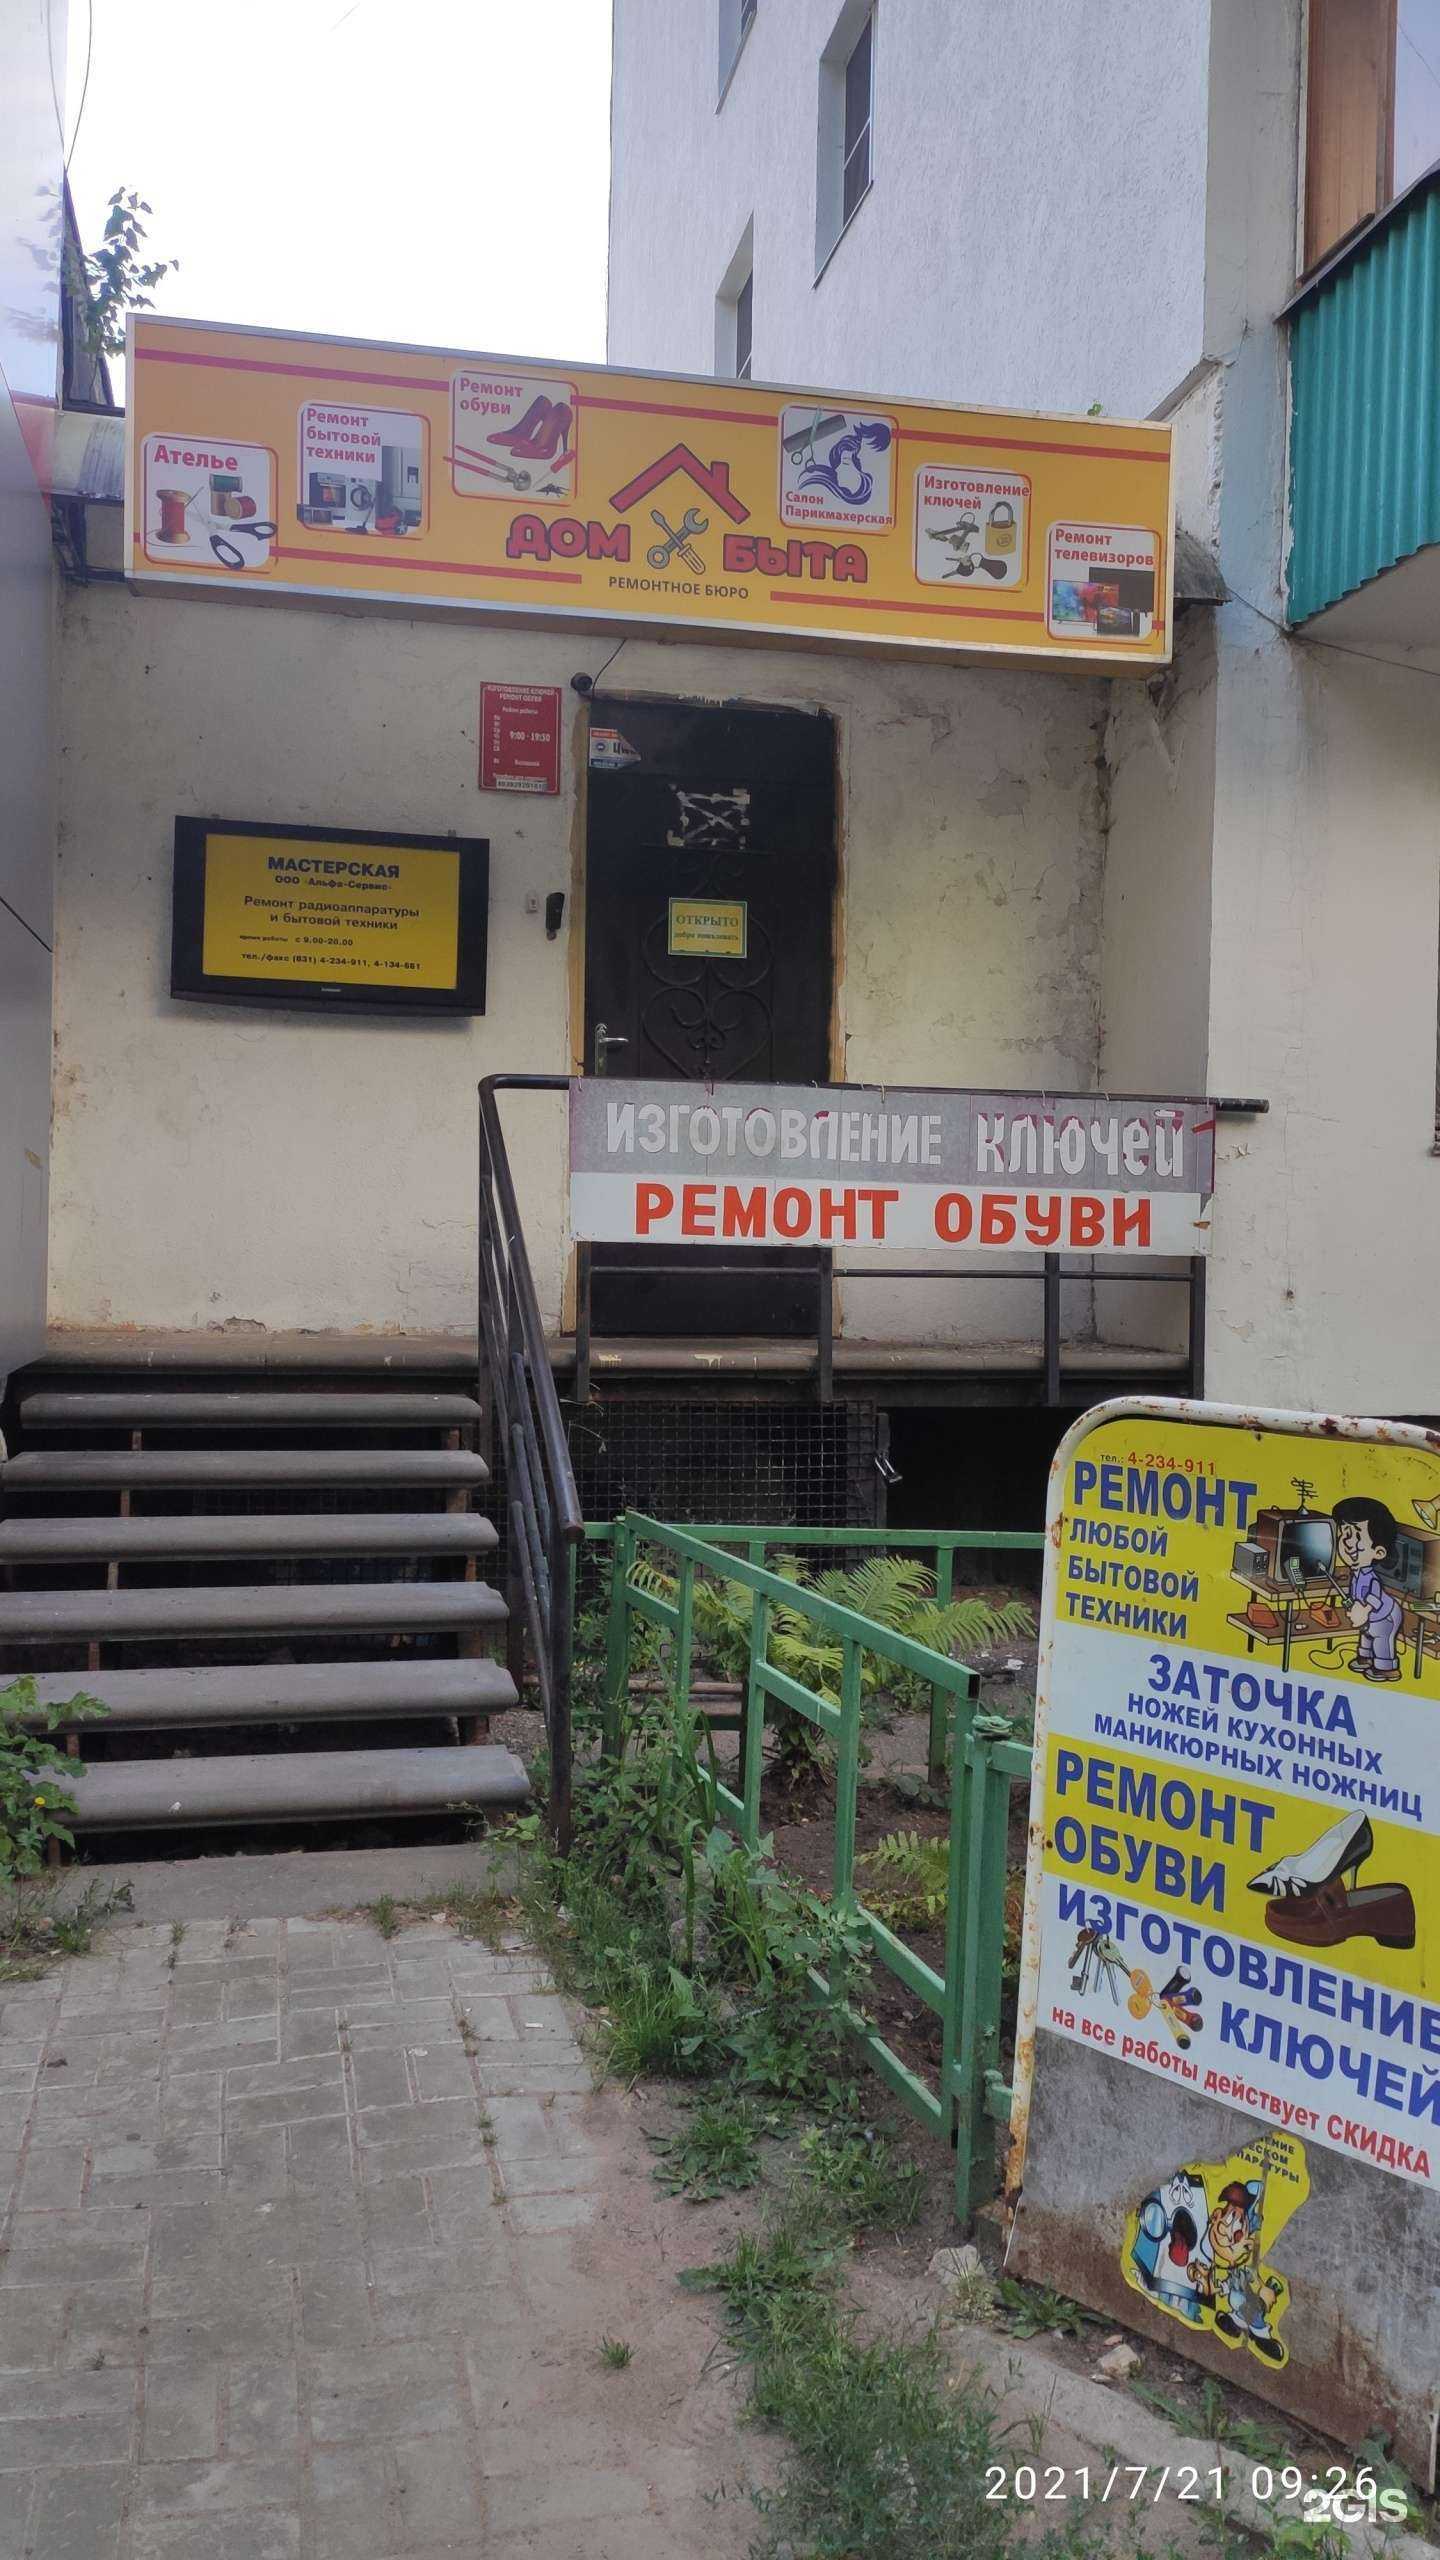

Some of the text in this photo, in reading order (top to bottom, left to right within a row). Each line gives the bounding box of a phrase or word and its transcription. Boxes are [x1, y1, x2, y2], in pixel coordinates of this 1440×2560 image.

[459, 377, 523, 398] Ремонт
[306, 407, 369, 427] Ремонт
[459, 397, 511, 415] обуви
[306, 426, 381, 446] бытовой
[153, 444, 239, 471] Ателье
[306, 446, 376, 464] техники
[785, 491, 824, 505] Салон
[924, 475, 1030, 497] Изготовление
[924, 495, 982, 510] ключей
[785, 505, 893, 526] Парикмахерская
[506, 513, 868, 584] ДОМ БЫТА
[1055, 528, 1112, 546] Ремонт
[1055, 548, 1154, 566] телевизоров
[608, 576, 749, 599] РЕМОНТНОЕ БЮРО
[268, 856, 400, 879] МАСТЕРСКАЯ
[275, 875, 300, 885] ООО
[244, 895, 420, 918] Ремонт радиоаппаратуры
[270, 913, 398, 930] и бытовой техники
[675, 914, 739, 928] ОТКРЫТО
[606, 1102, 941, 1165] ИЗГОТОВЛЕНИЕ
[635, 1182, 1151, 1248] РЕМОНТ ОБУВИ
[1127, 1451, 1216, 1476] 4-234-911
[1073, 1460, 1257, 1531] РЕМОНТ
[1069, 1517, 1169, 1557] ЛЮБОЙ
[1067, 1555, 1199, 1602] БЫТОВОЙ
[1065, 1592, 1187, 1639] ТЕХНИКИ
[1148, 1653, 1357, 1738] ЗАТОЧКА
[1128, 1693, 1384, 1776] НОЖЕЙ КУХОННЫХ
[1094, 1713, 1423, 1822] МАНИКЮРНЫХ НОЖНИЦ
[1056, 1749, 1275, 1853] РЕМОНТ
[1054, 1815, 1226, 1913] ОБУВИ
[1058, 1883, 1440, 2055] ИЗГОТОВЛЕНИЕ
[1220, 2001, 1440, 2127] КЛЮЧЕЙ
[1051, 2006, 1431, 2179] на все работы действует СКИДКА
